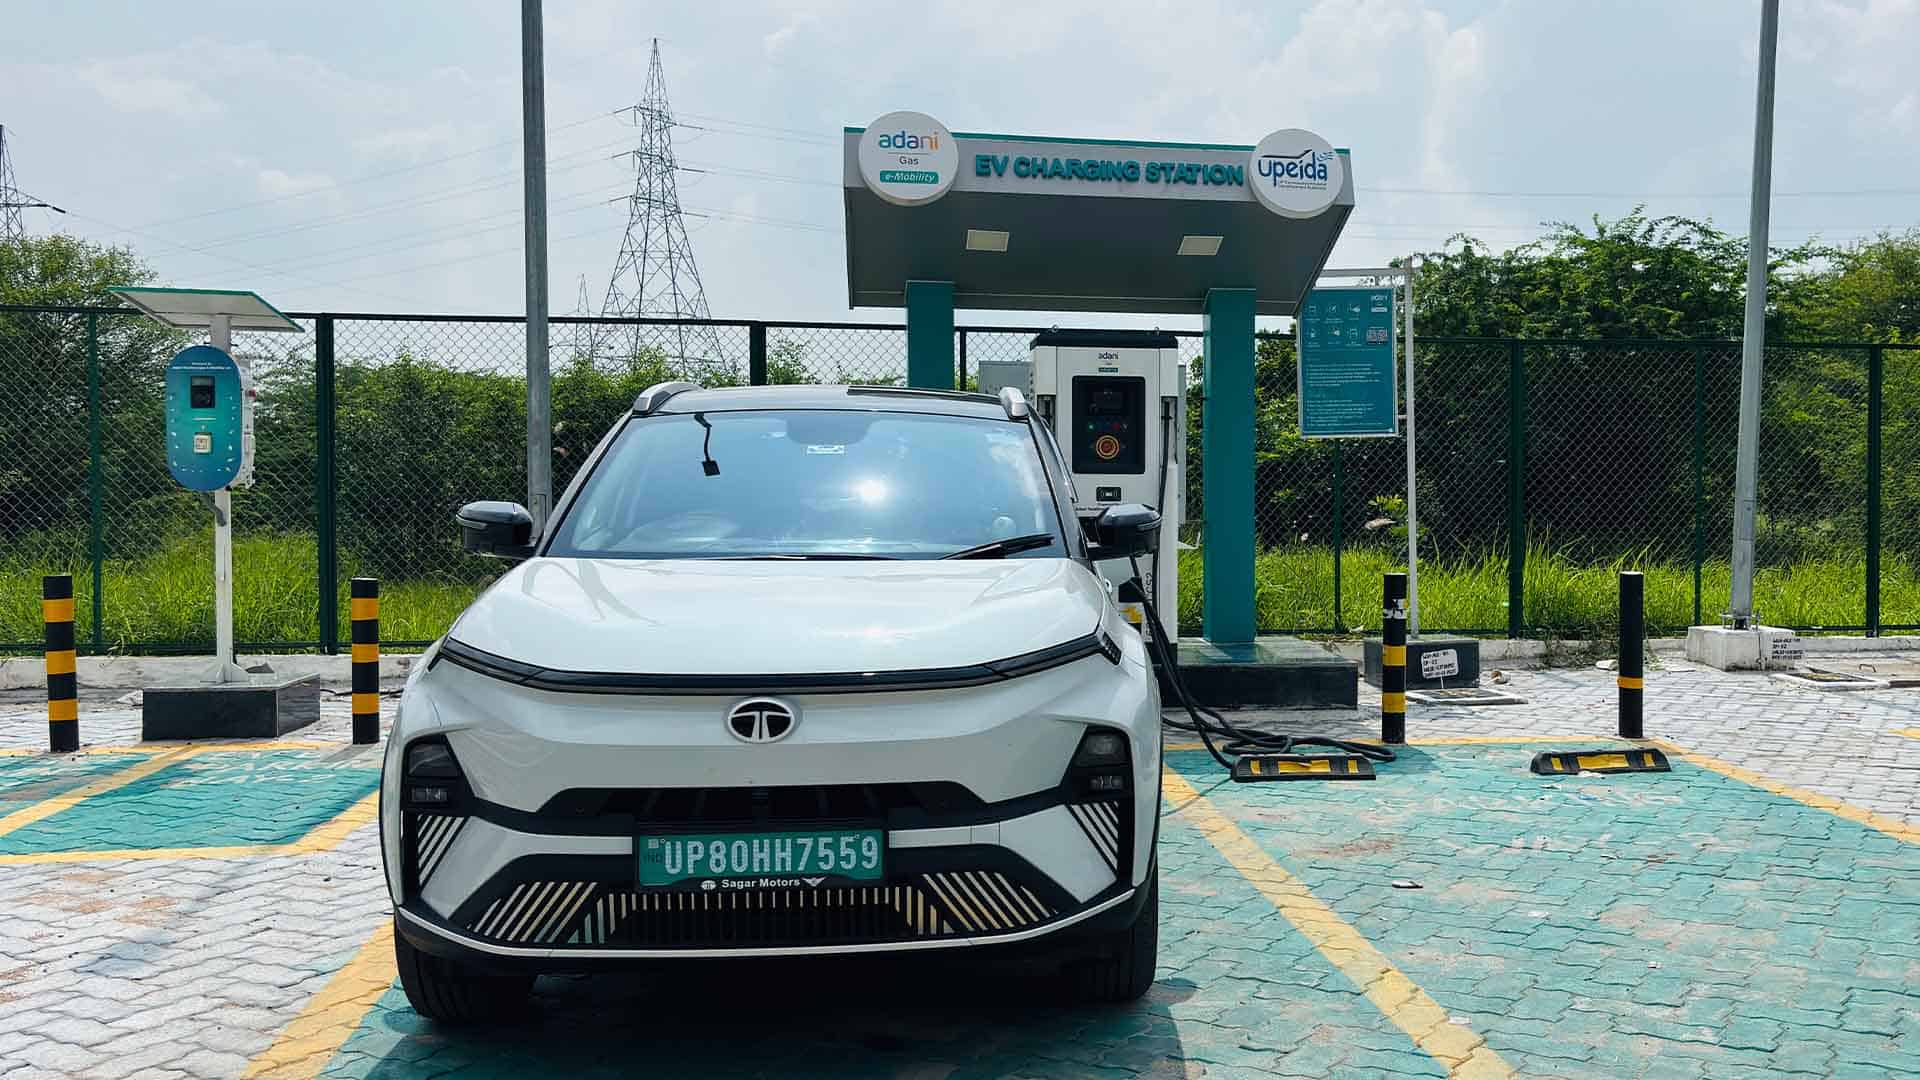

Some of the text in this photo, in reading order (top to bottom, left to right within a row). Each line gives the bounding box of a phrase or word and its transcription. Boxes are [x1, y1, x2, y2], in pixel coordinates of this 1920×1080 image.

[879, 130, 939, 150] adani
[899, 156, 919, 165] Gas
[975, 154, 1244, 186] EV CHARGING STATION
[1258, 151, 1327, 187] upeida
[885, 172, 935, 183] e-Mobility
[664, 835, 879, 874] UP80HH7559
[721, 878, 801, 890] Sagar Motors
